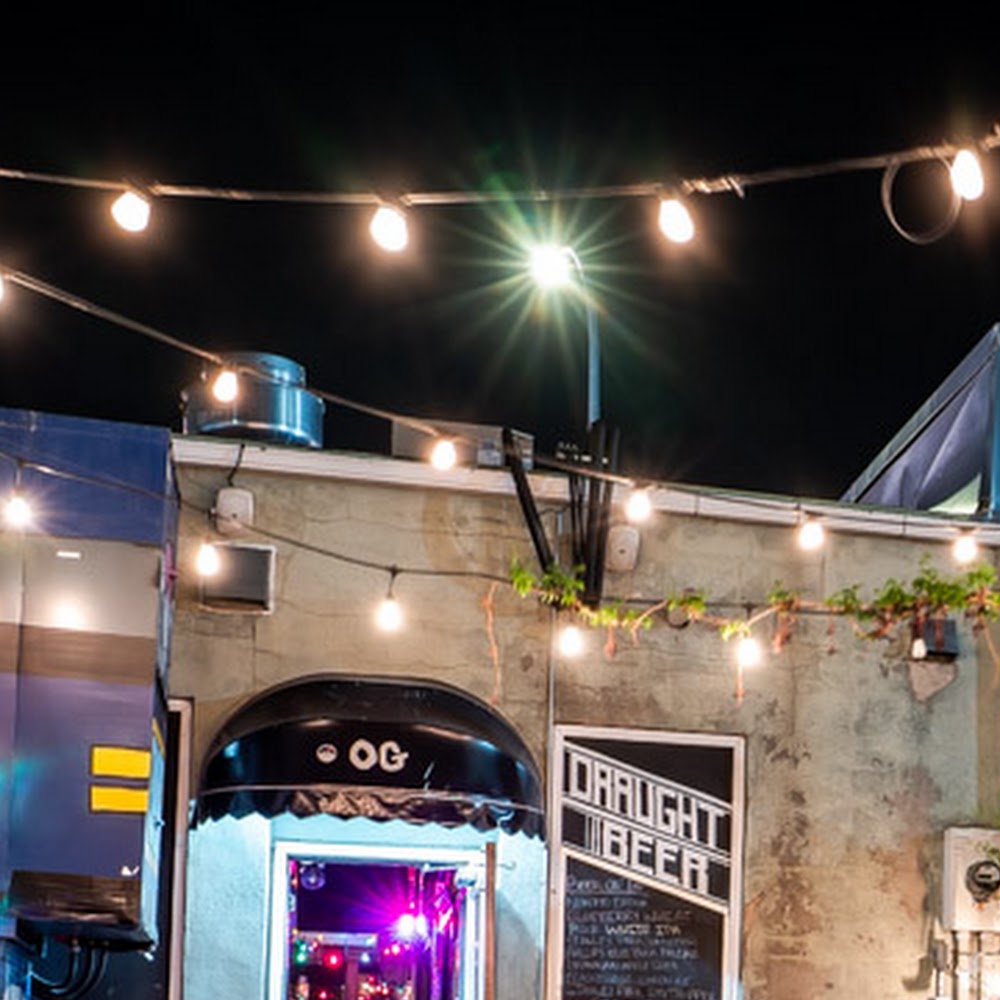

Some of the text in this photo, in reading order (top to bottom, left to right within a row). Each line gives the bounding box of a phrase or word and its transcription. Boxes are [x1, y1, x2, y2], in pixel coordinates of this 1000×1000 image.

[349, 738, 409, 773] OG
[569, 750, 727, 847] DRAUGHT
[602, 821, 708, 894] BEER
